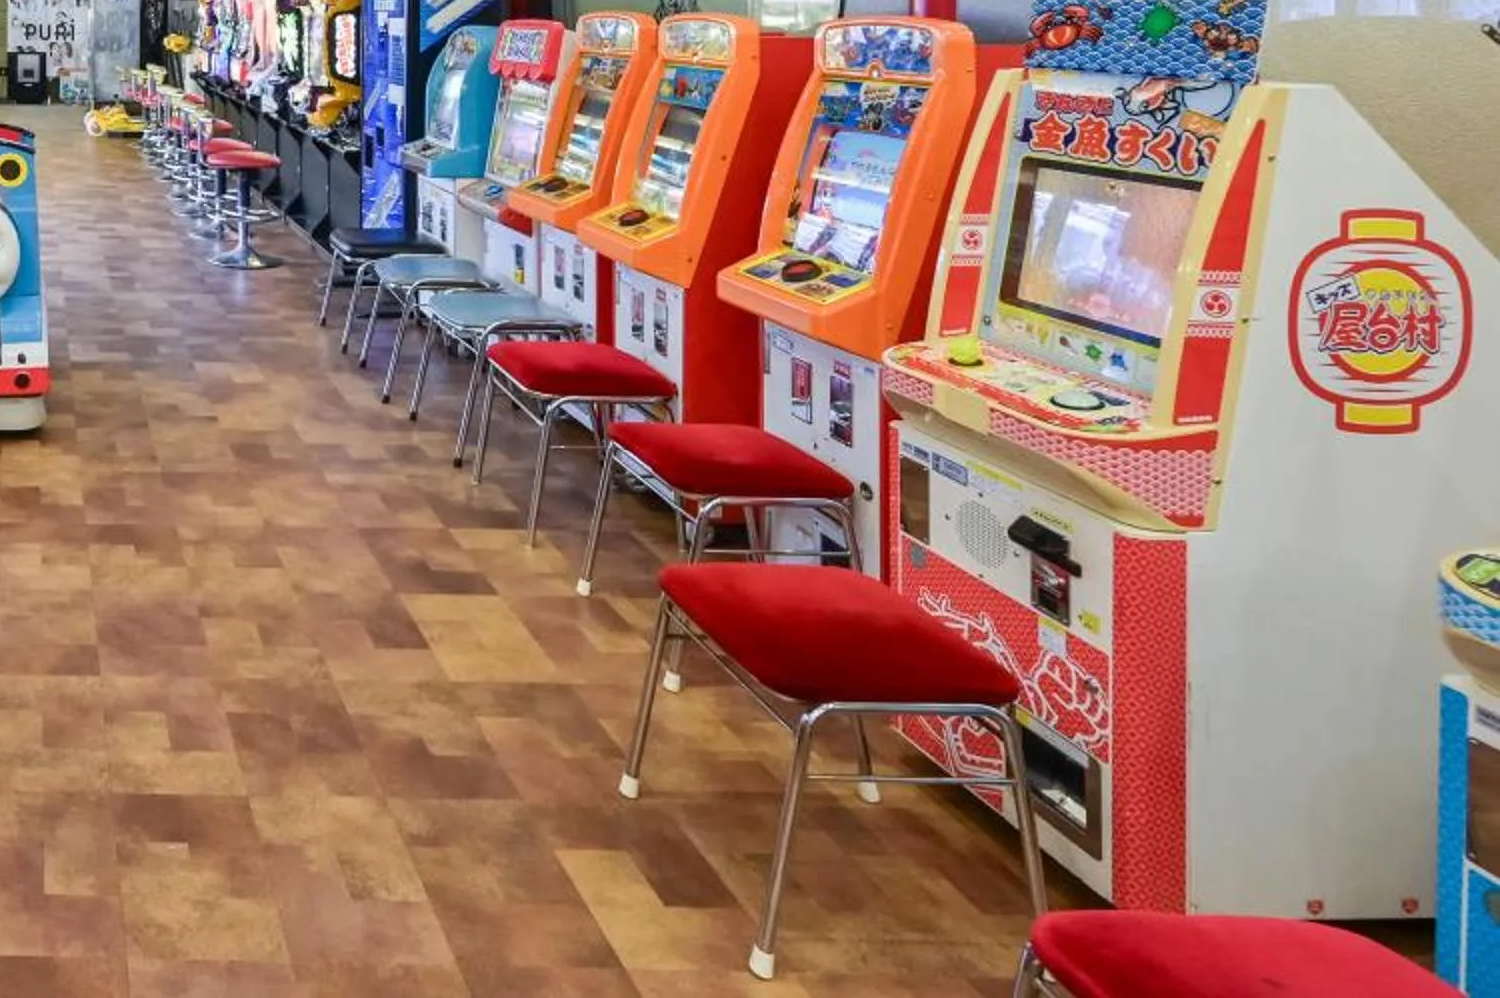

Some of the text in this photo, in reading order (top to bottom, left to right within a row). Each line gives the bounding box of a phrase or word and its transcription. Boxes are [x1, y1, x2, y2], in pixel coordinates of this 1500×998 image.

[1029, 109, 1218, 176] 金魚すくい
[1314, 281, 1354, 306] キッズ
[1318, 300, 1445, 354] 屋台村
